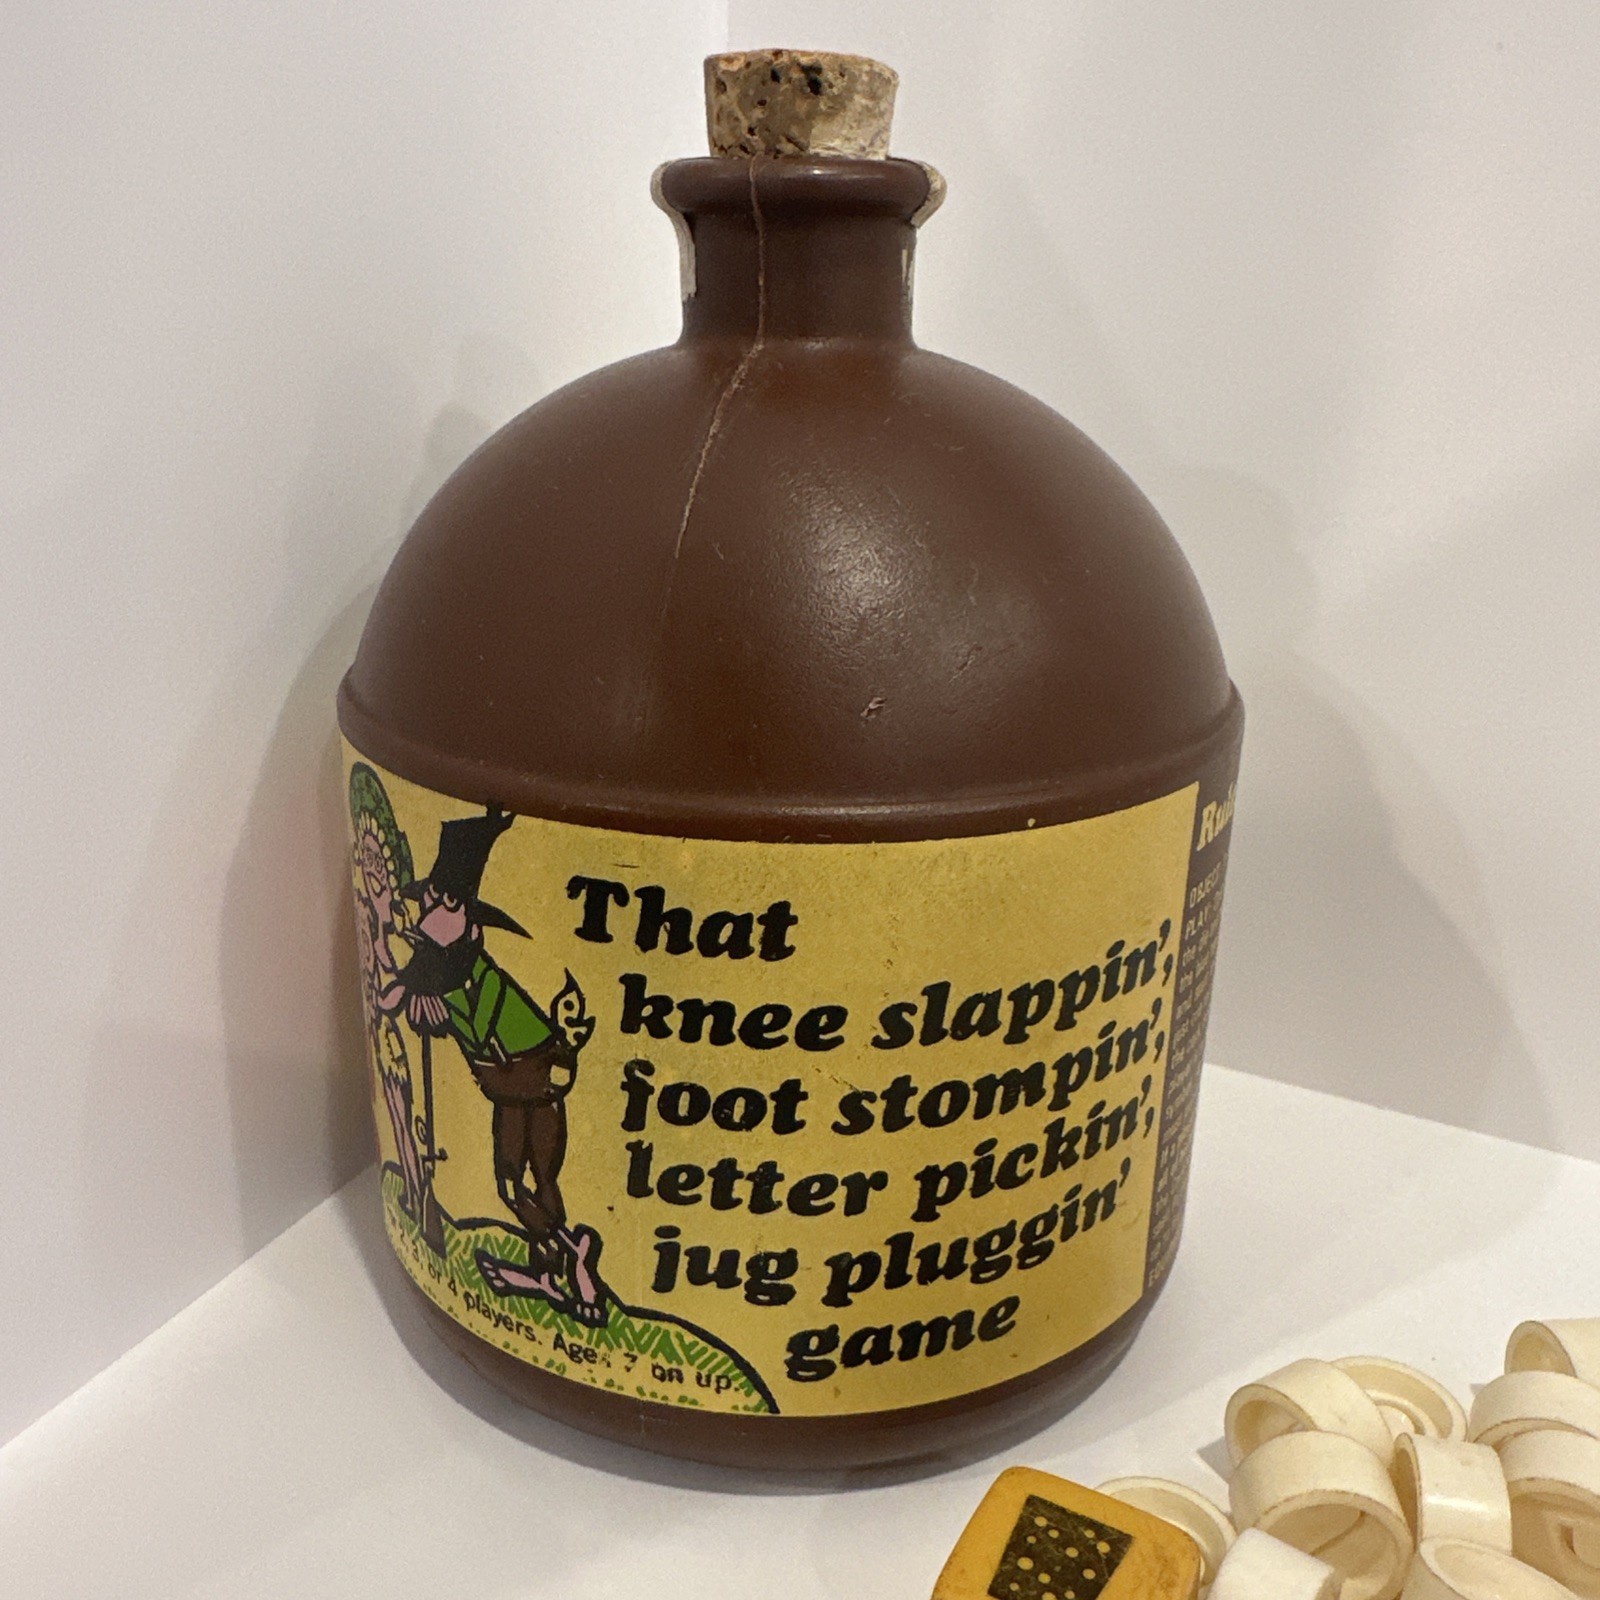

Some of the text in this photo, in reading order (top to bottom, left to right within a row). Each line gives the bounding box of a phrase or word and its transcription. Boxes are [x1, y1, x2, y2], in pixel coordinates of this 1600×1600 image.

[565, 874, 799, 963] That
[618, 972, 849, 1052] knee
[870, 919, 1174, 1051] slappin',
[619, 1058, 809, 1136] foot
[830, 997, 1166, 1136] stompin',
[625, 1139, 890, 1218] letter
[910, 1074, 1156, 1223] pickin',
[651, 1225, 799, 1307] jug
[820, 1157, 1132, 1309] pluggin'
[428, 1262, 442, 1285] or
[448, 1276, 458, 1296] 4
[463, 1291, 543, 1346] players.
[623, 1352, 638, 1373] 7
[651, 1362, 684, 1384] on
[696, 1371, 740, 1394] up.
[783, 1294, 1021, 1384] game
